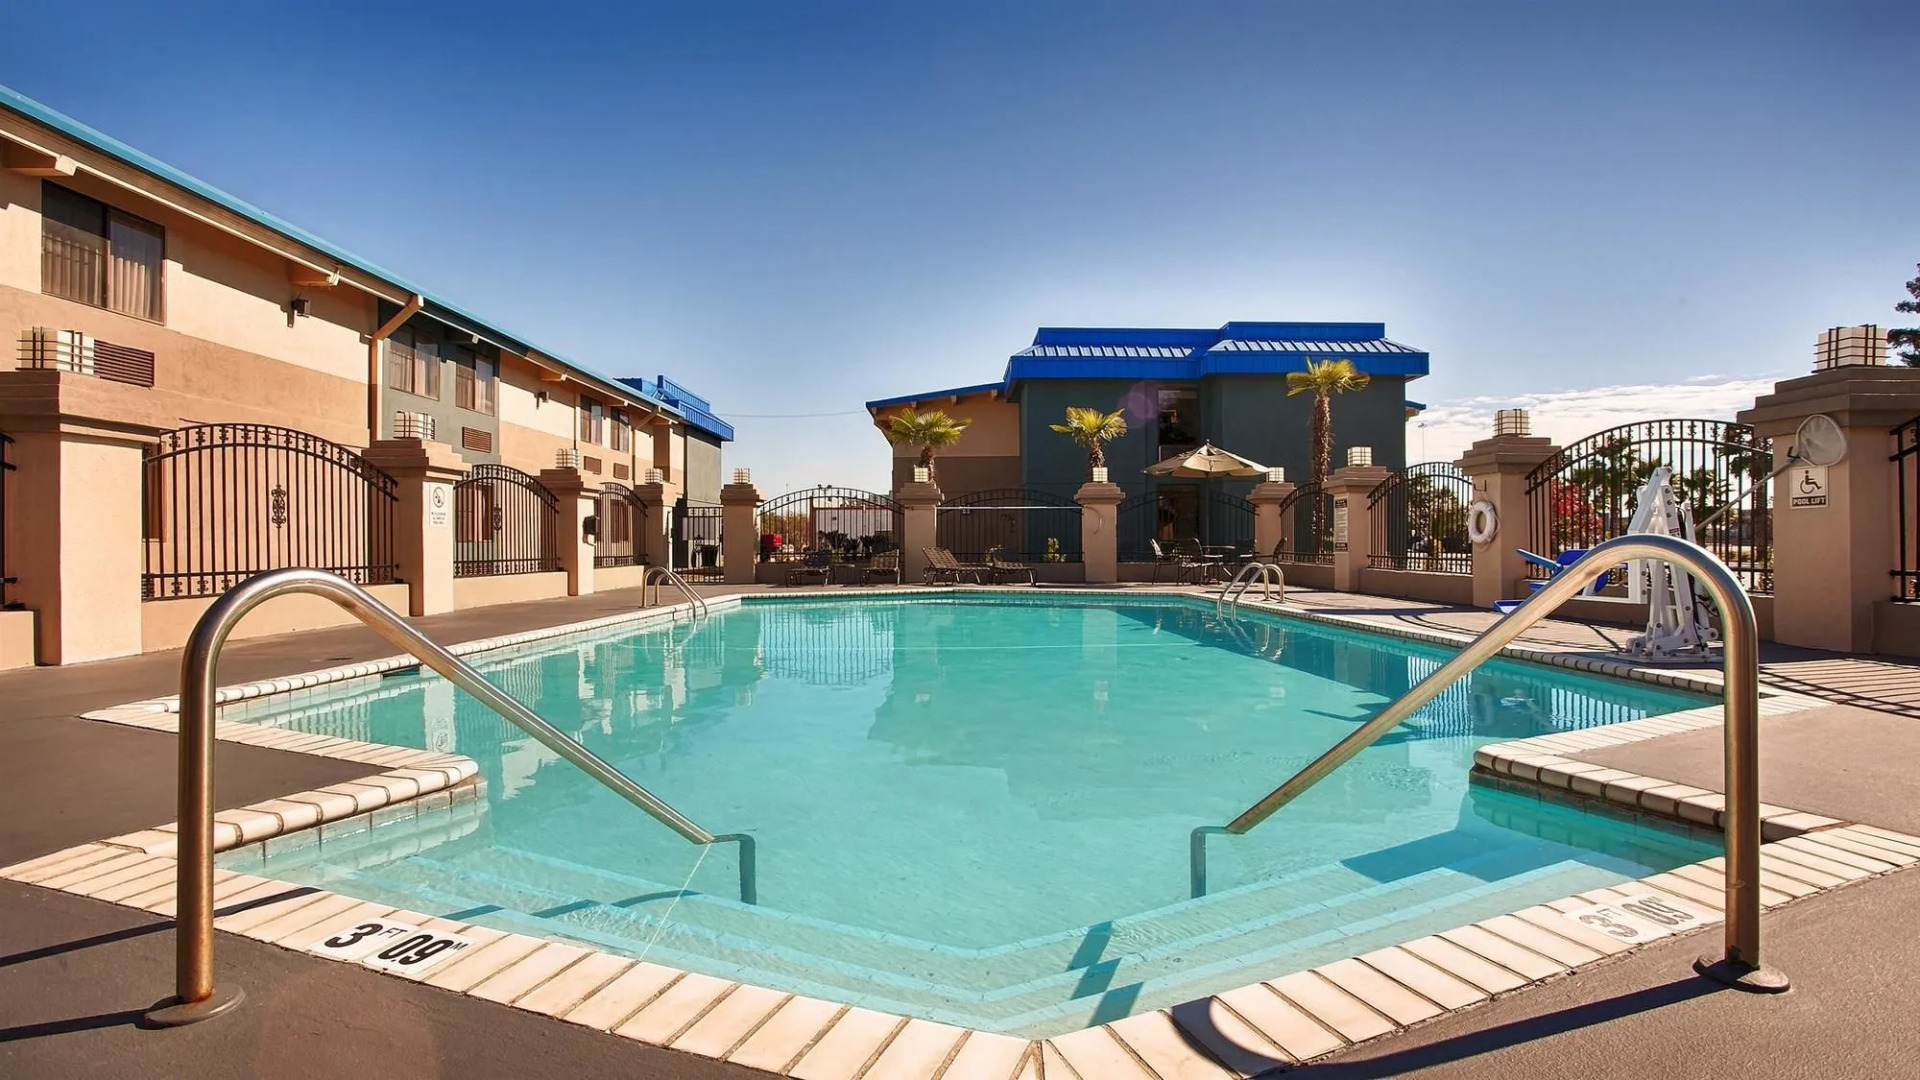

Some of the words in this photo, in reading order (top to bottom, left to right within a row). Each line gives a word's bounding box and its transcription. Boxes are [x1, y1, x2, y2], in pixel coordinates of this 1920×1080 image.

[1597, 908, 1622, 919] FT
[324, 923, 383, 948] 3
[378, 927, 408, 938] FT
[450, 942, 468, 950] M
[1579, 915, 1639, 938] 3
